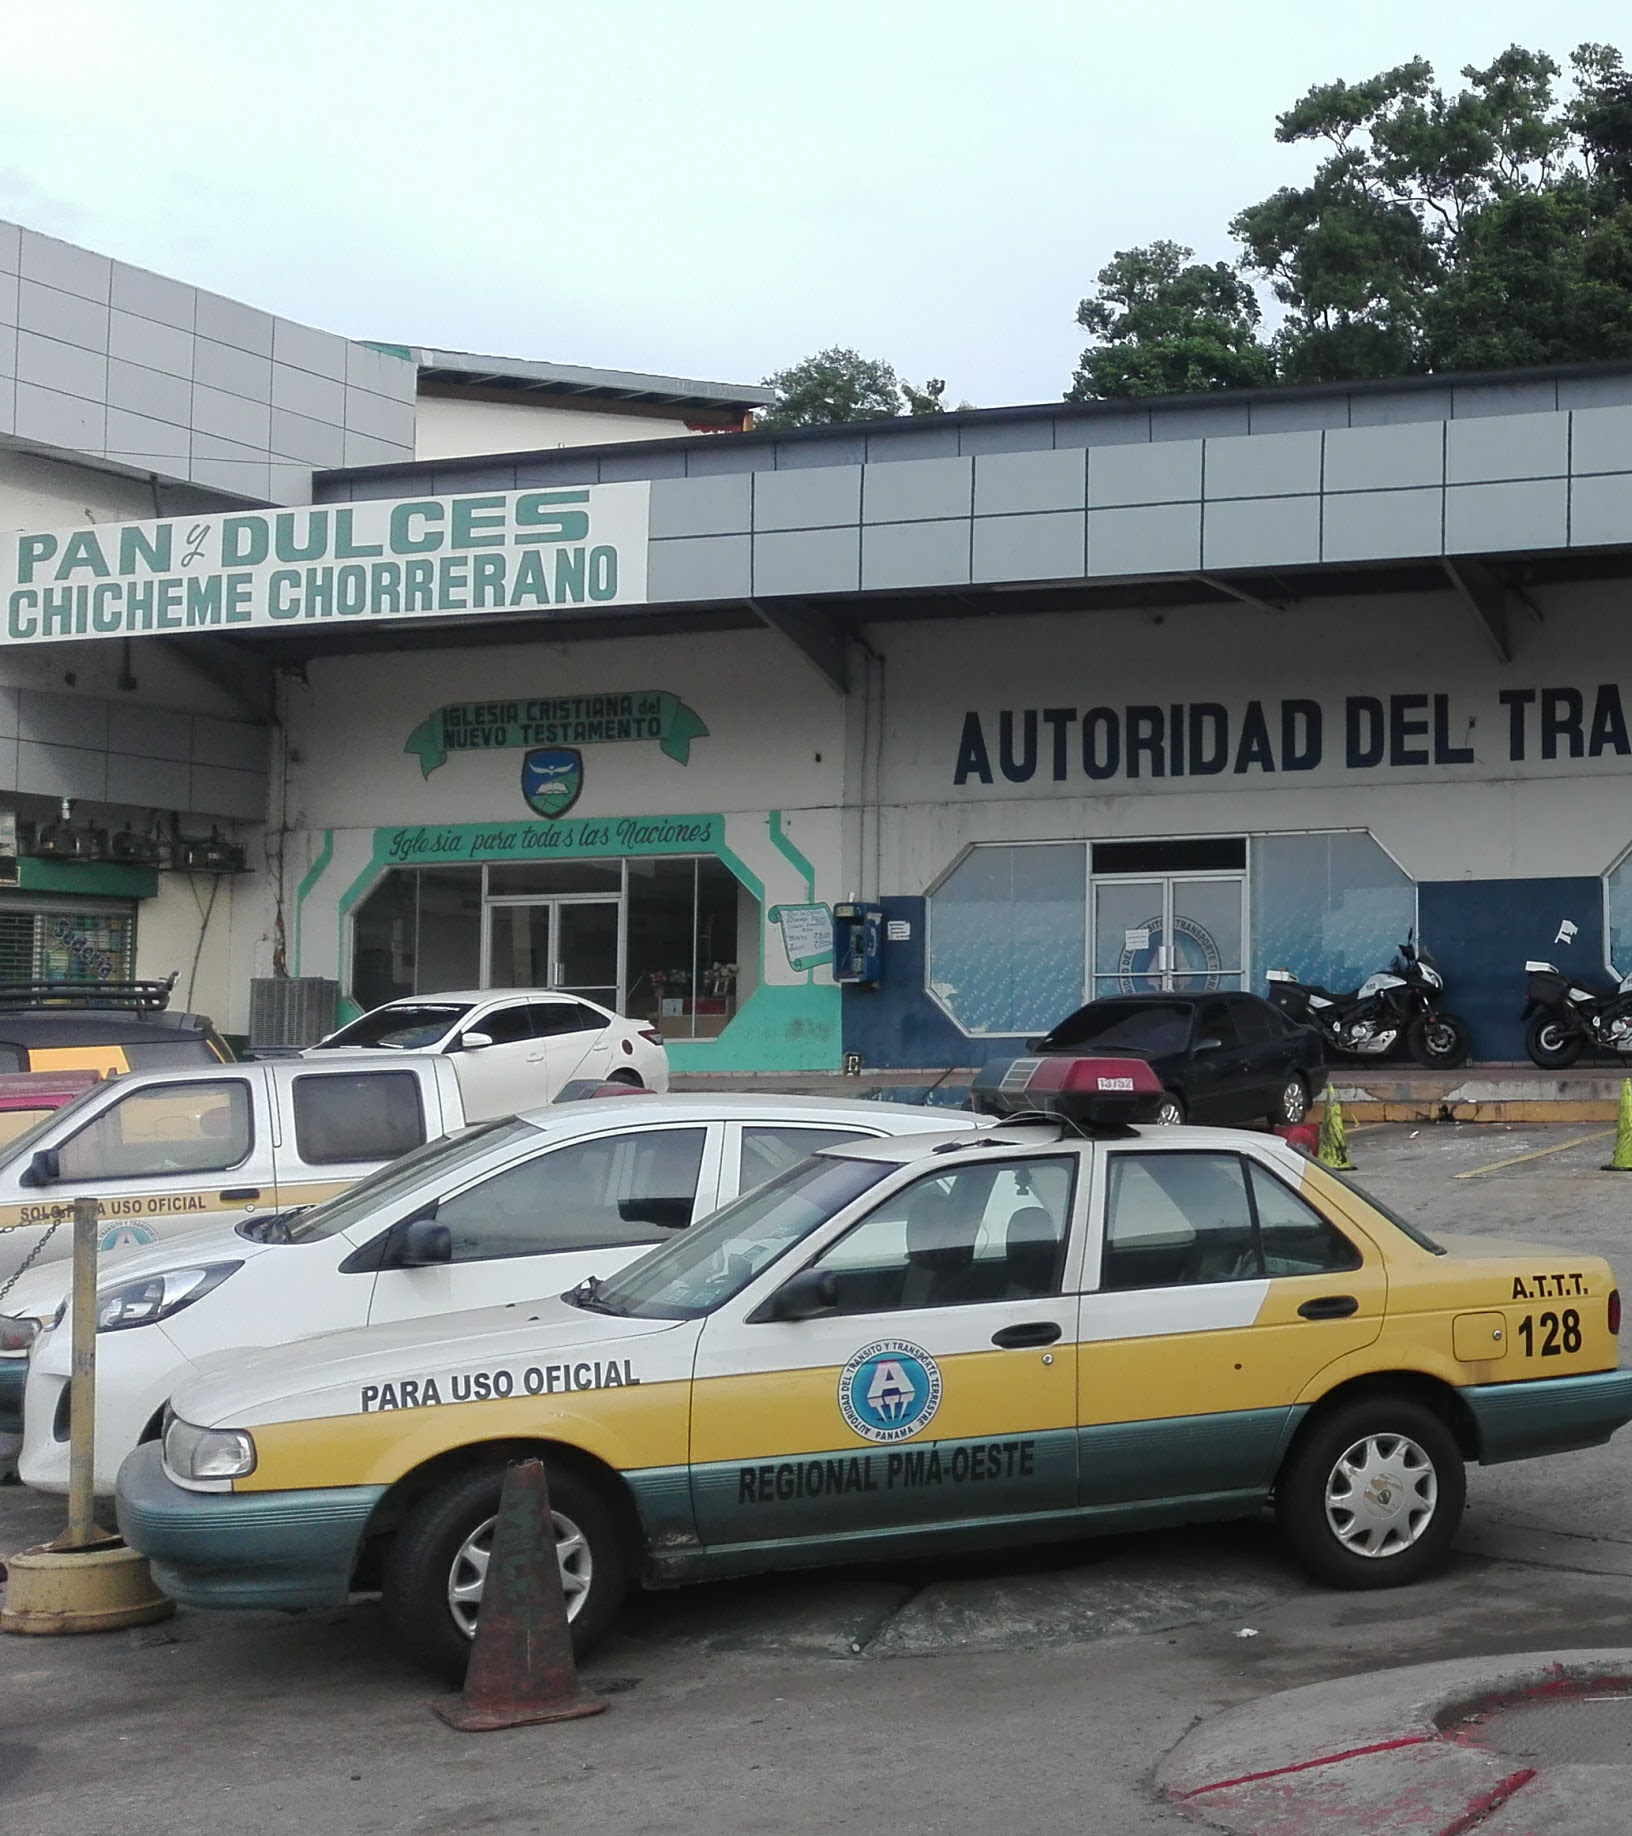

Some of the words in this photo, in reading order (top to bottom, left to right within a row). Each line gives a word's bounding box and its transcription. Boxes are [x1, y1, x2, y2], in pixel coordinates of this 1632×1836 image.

[17, 523, 173, 584] PAN
[180, 523, 213, 566] y
[220, 489, 591, 568] DULCES
[7, 571, 254, 640] CHICHEME
[267, 544, 619, 621] CHORRERANO
[442, 703, 518, 728] IGLESIA
[525, 695, 633, 723] CRISTIANA
[638, 696, 662, 717] del
[442, 726, 507, 749] NUEVO
[519, 717, 662, 745] TESTAMENTO
[953, 698, 1323, 785] AUTORIDAD
[1345, 693, 1475, 769] DEL
[389, 828, 463, 861] Iglesia
[470, 831, 516, 857] para
[520, 825, 573, 848] todas
[579, 823, 609, 847] las
[616, 818, 711, 848] Naciones
[67, 1203, 107, 1218] PA
[112, 1200, 142, 1214] USO
[147, 1196, 206, 1212] OFICIAL
[1511, 1273, 1589, 1300] A.T.T.T.
[884, 1342, 890, 1350] Y
[1517, 1309, 1582, 1358] 128
[847, 1344, 882, 1374] TRANSITO
[893, 1342, 937, 1377] TRANSPORTE
[361, 1378, 441, 1413] PARA
[450, 1370, 515, 1405] USO
[522, 1359, 640, 1396] OFICIAL
[842, 1376, 852, 1392] DEL
[917, 1377, 939, 1426] TERRESTRE
[841, 1395, 871, 1435] AUTORIDAD
[875, 1426, 914, 1440] PANAMA
[739, 1455, 879, 1505] REGIONAL
